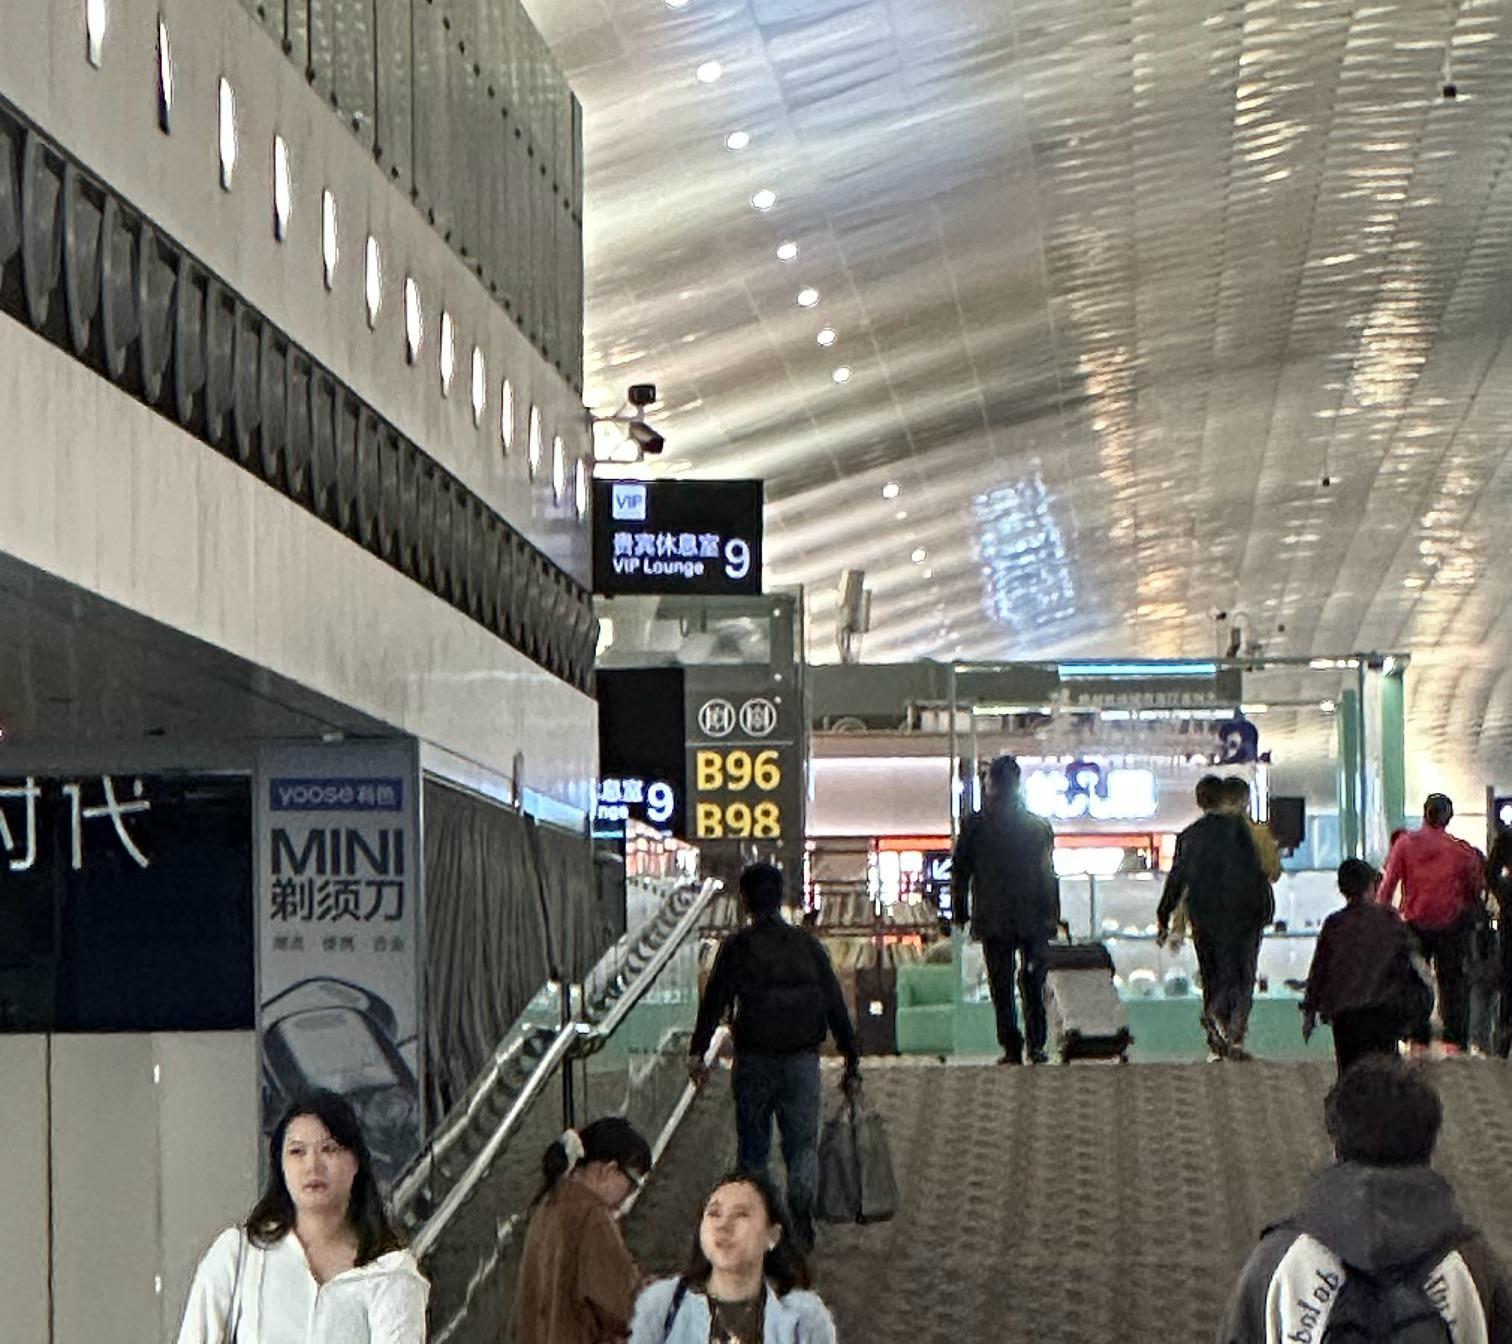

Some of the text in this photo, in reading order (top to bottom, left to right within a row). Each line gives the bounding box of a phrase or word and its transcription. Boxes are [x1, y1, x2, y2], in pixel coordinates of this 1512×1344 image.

[616, 494, 642, 510] VIP
[613, 557, 705, 578] VIP Lounge
[725, 538, 750, 579] 9
[697, 750, 781, 791] B96
[278, 785, 354, 806] yoose
[647, 782, 675, 823] 9
[697, 801, 781, 839] B98
[270, 827, 404, 876] MINI
[269, 877, 404, 922] 剃须刀
